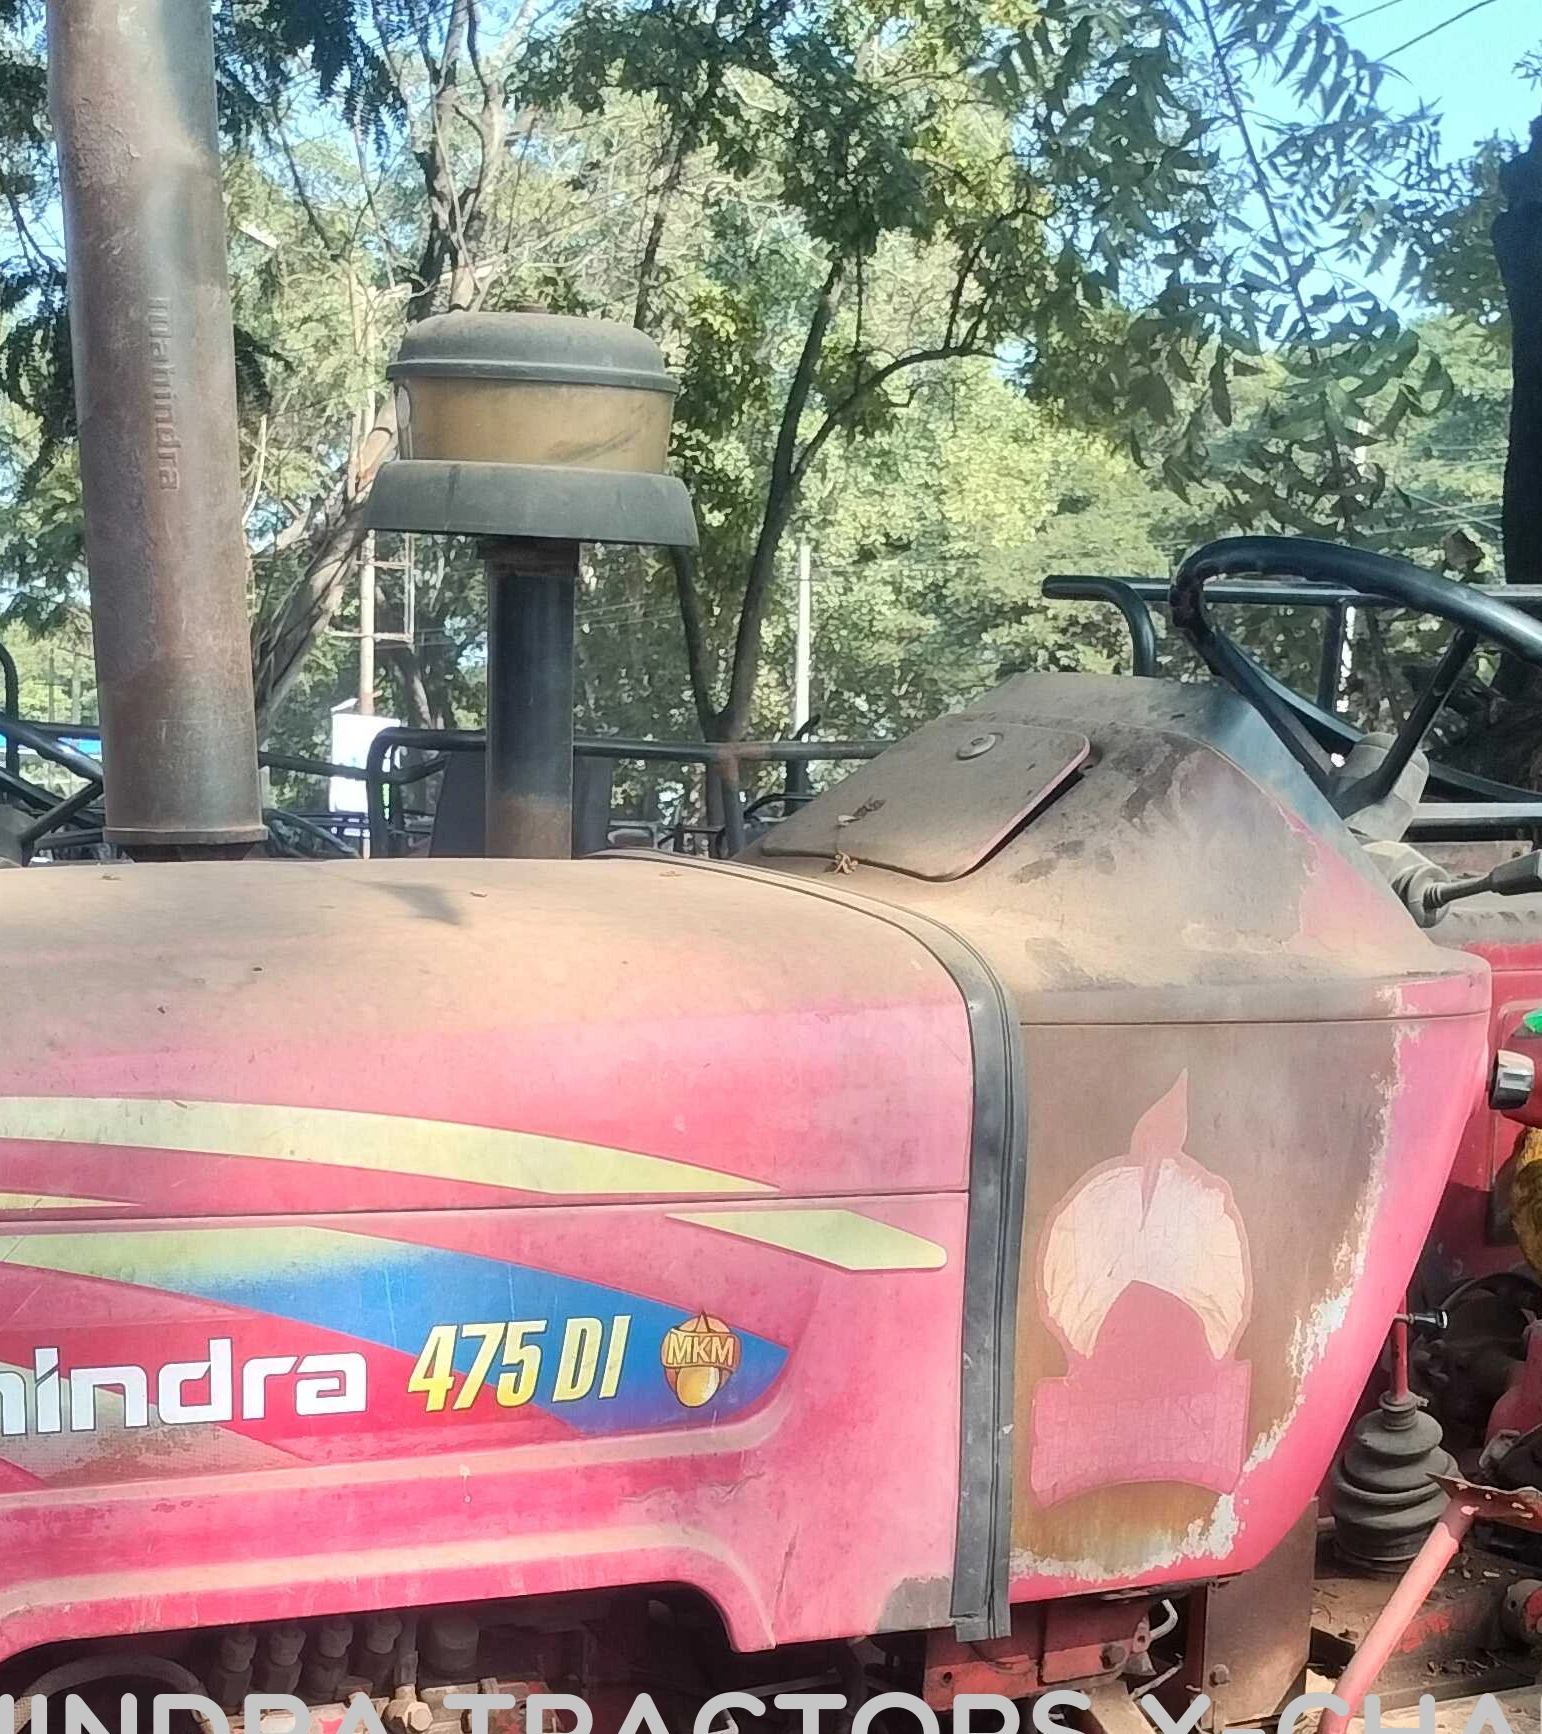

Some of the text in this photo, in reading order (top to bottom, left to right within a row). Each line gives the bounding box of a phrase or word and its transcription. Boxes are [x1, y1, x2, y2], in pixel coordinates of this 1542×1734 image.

[408, 1319, 549, 1412] 475
[553, 1315, 633, 1403] DI
[666, 1334, 736, 1367] MKM
